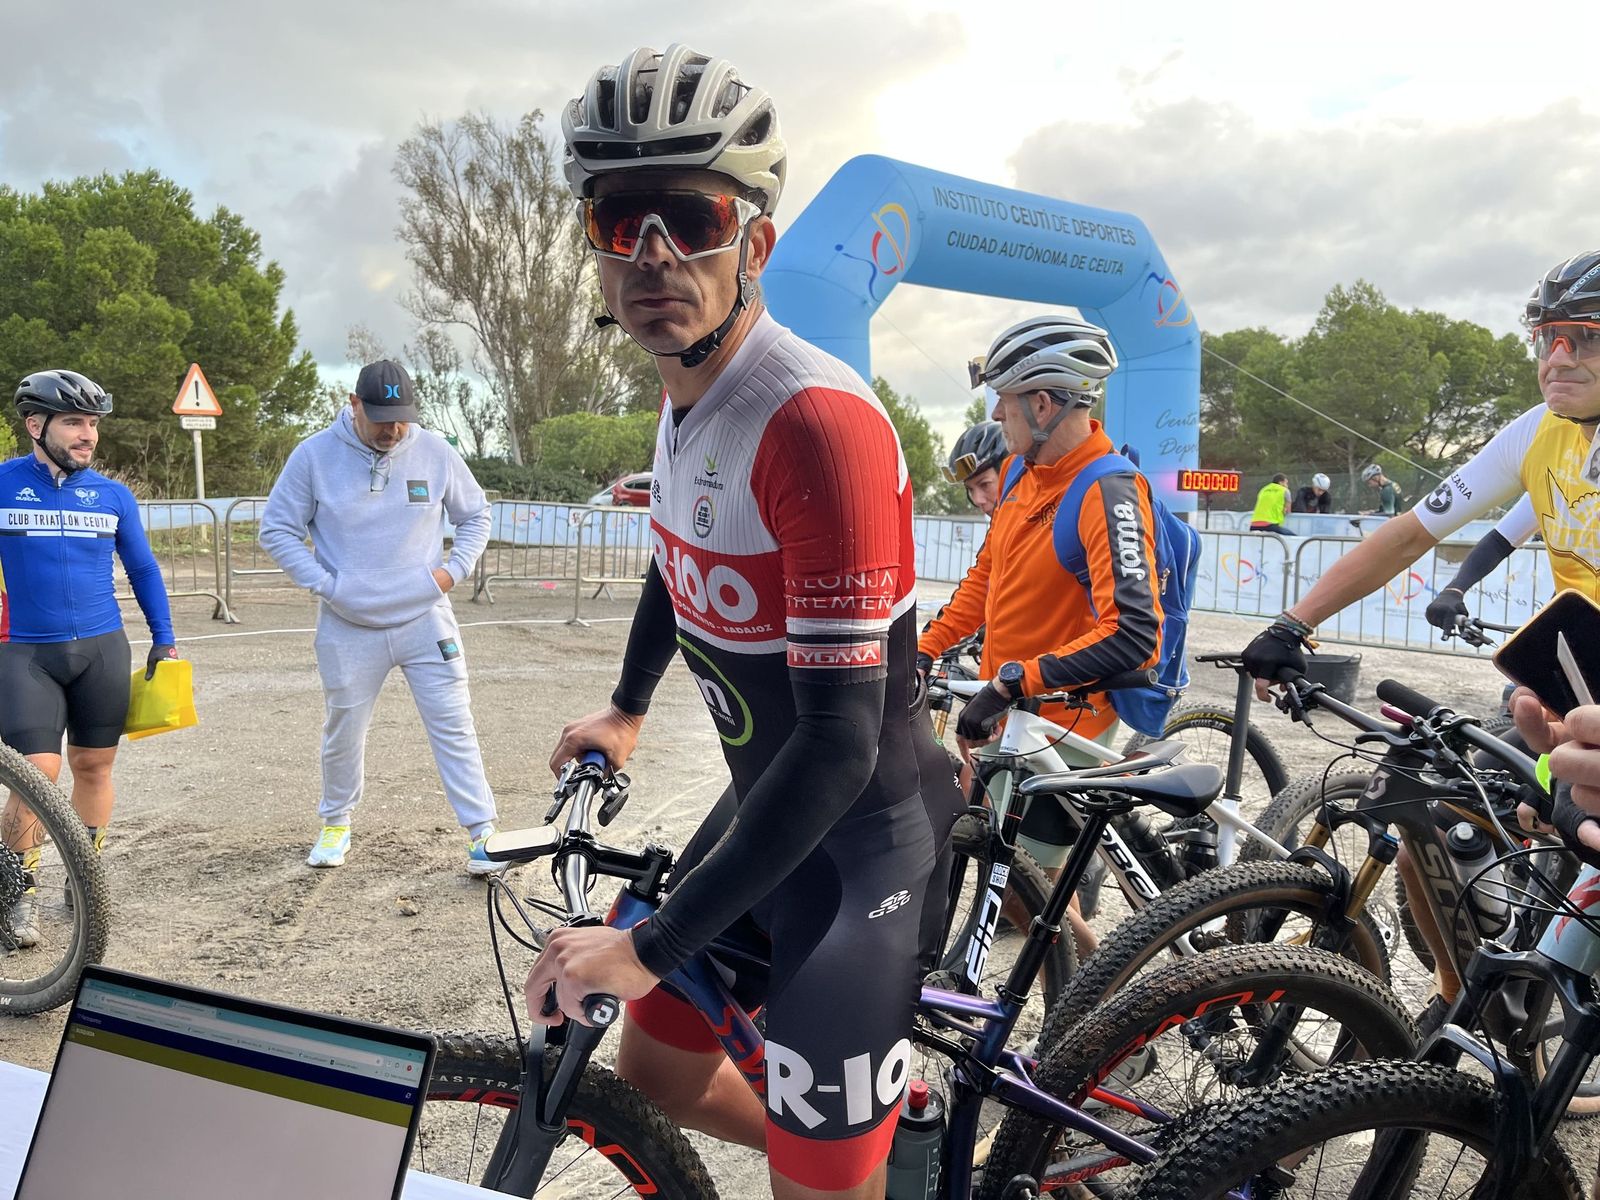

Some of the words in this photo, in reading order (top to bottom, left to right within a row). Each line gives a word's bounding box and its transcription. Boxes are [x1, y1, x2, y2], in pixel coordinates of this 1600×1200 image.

[933, 186, 1008, 221] INSTITUTO
[1051, 214, 1071, 234] DE
[1072, 218, 1136, 246] DEPORTES
[947, 231, 998, 254] CIUDAD
[998, 241, 1067, 267] AUTÓNOMA
[1070, 254, 1088, 270] DE
[1088, 257, 1124, 275] CEUTA
[8, 513, 29, 525] CLUB
[34, 514, 79, 526] TRIATLÓN
[84, 516, 110, 528] CEUTA
[651, 527, 759, 623] R-100
[785, 590, 895, 610] TREMEÑ
[722, 623, 774, 635] BADAJOZ
[764, 1038, 911, 1130] R-10
